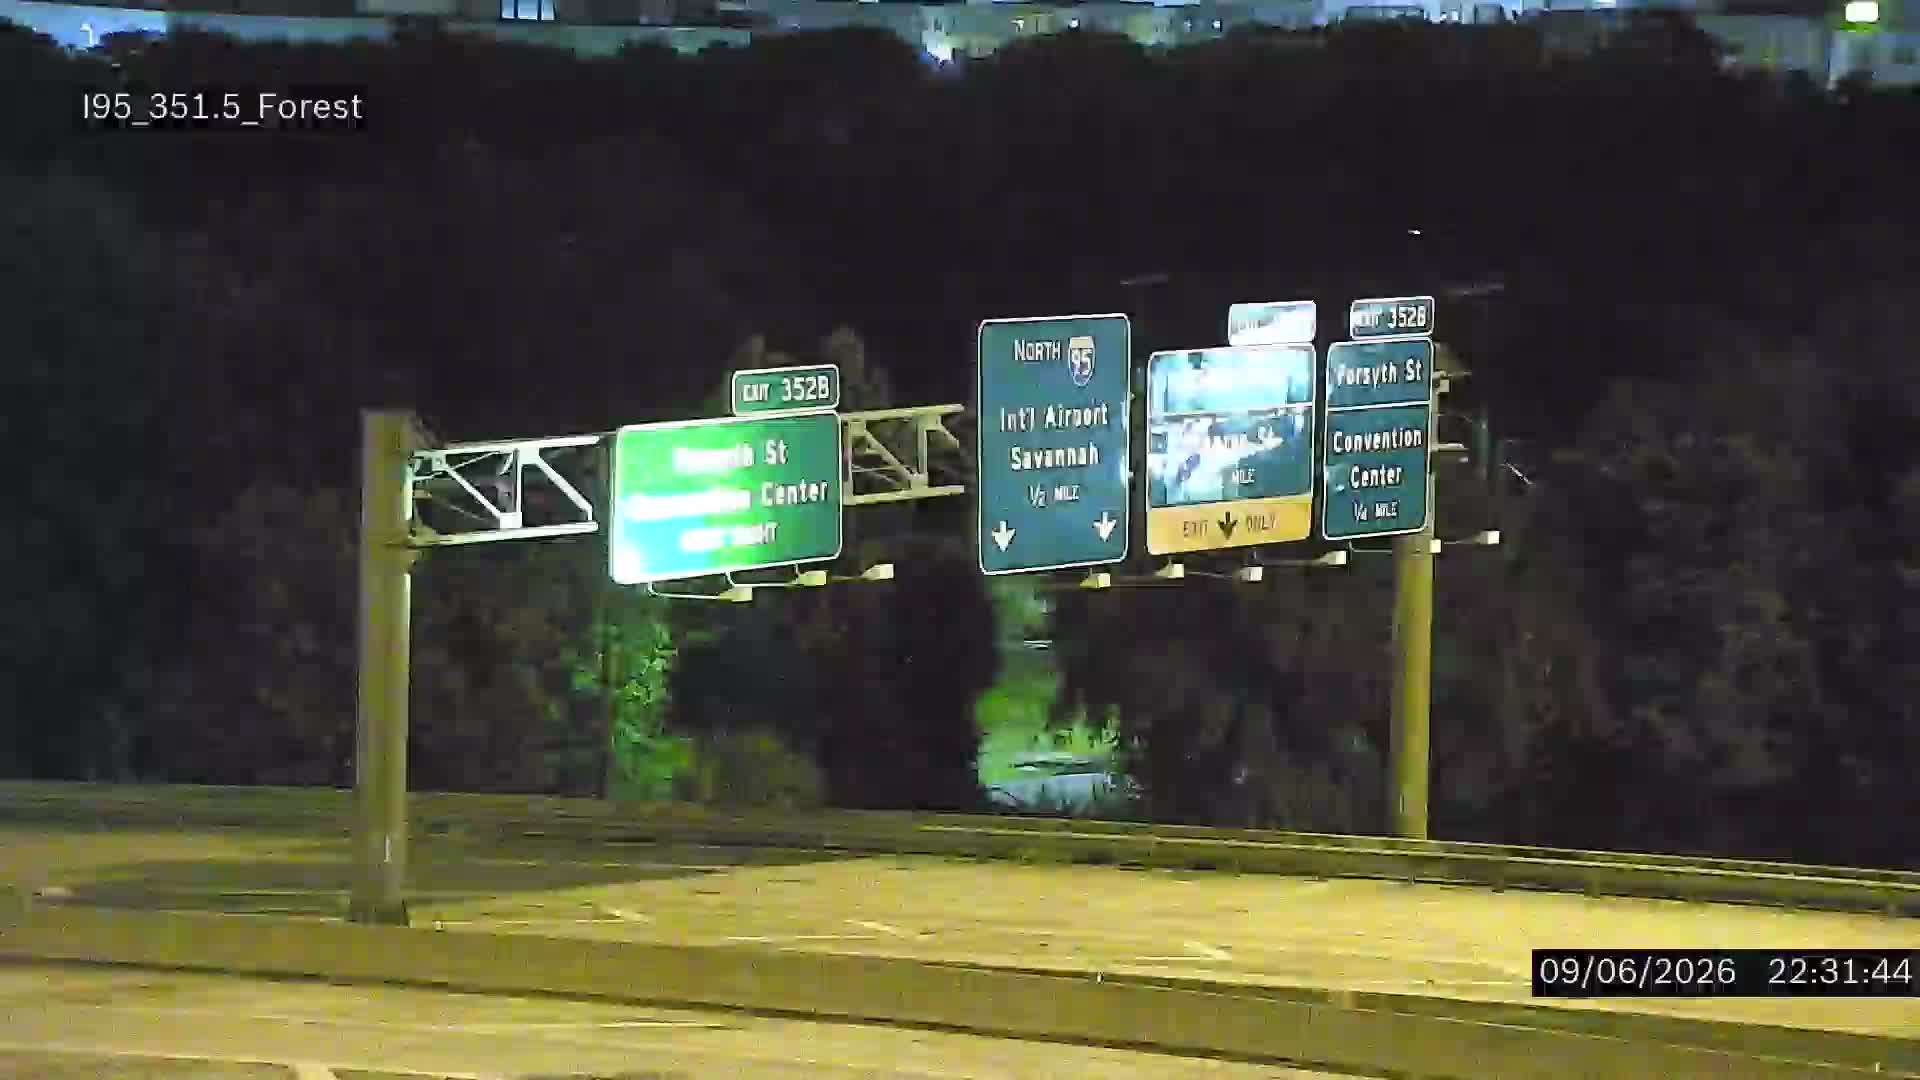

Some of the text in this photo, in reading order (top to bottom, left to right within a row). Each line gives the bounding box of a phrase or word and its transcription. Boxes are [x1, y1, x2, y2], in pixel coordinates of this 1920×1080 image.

[1070, 351, 1093, 377] 95
[1406, 357, 1423, 383] St
[782, 375, 830, 402] 352B
[1044, 402, 1109, 430] Airport
[764, 438, 789, 466] St
[1333, 427, 1422, 453] Convention
[1010, 444, 1099, 471] Savannah
[1350, 464, 1403, 490] Center
[761, 478, 829, 507] Center
[1246, 514, 1277, 536] ONLY
